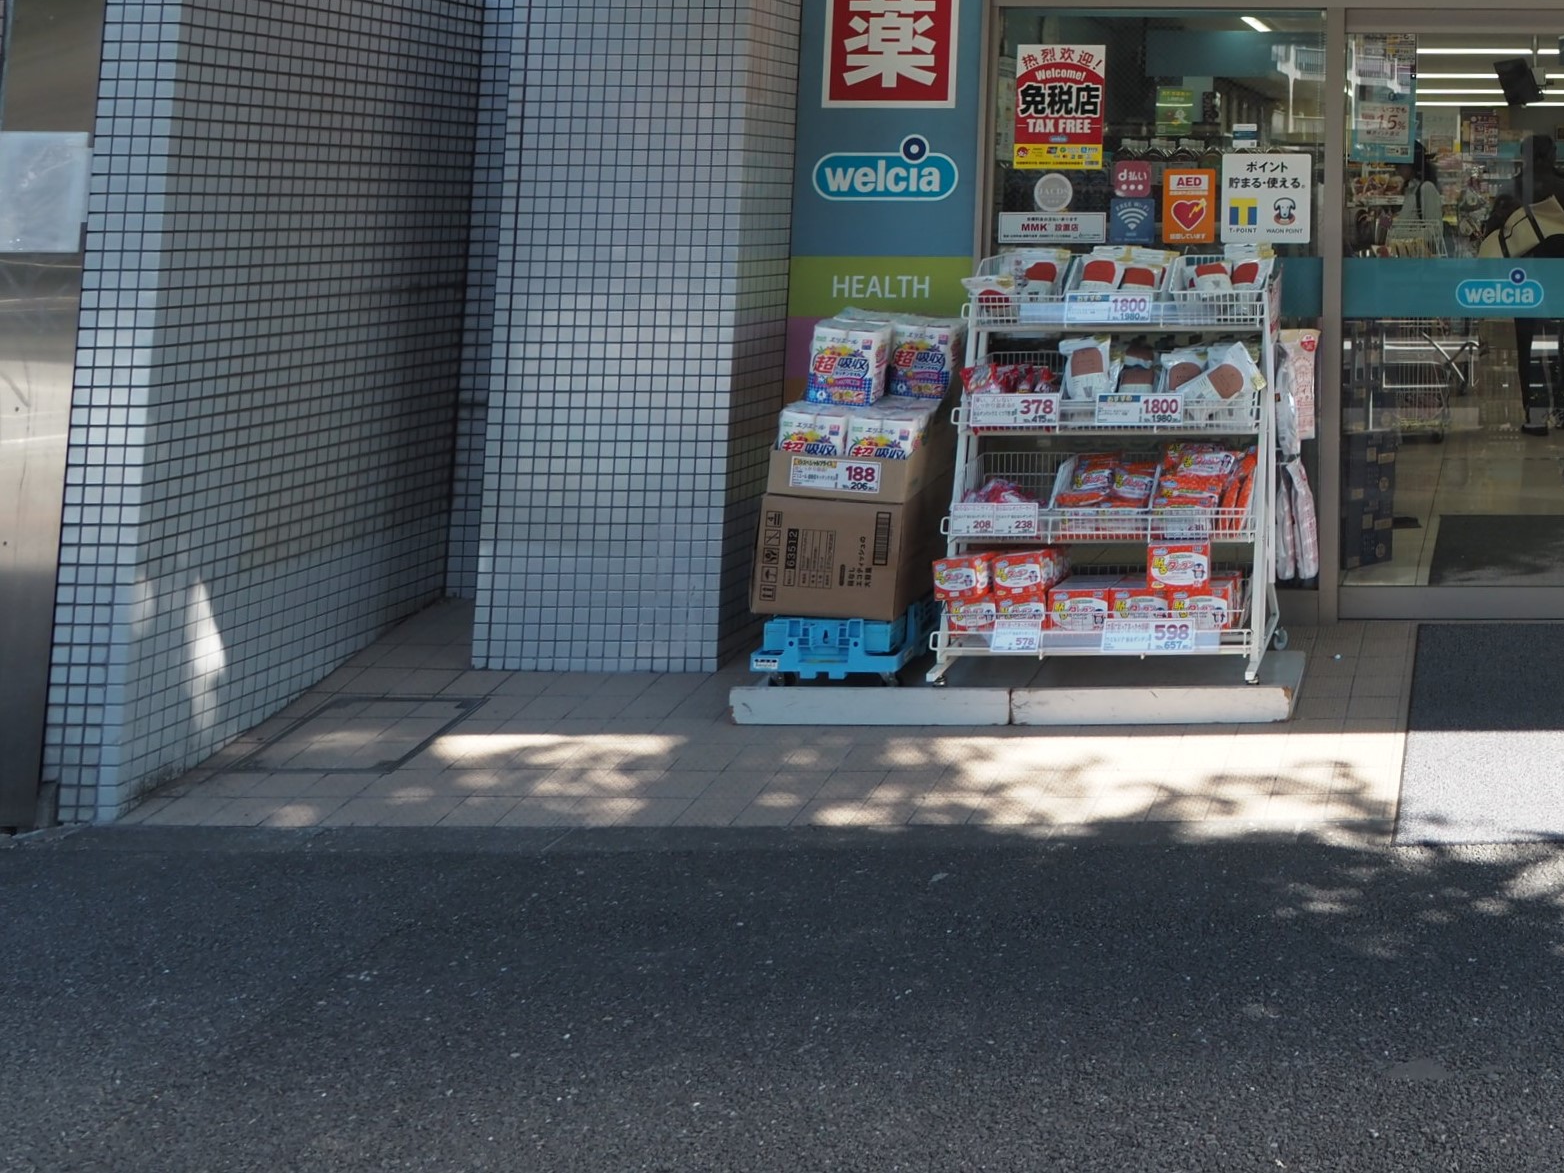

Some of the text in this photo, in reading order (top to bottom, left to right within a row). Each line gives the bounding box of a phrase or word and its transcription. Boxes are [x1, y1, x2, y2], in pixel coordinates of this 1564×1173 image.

[1035, 68, 1087, 82] Welcome!
[1019, 83, 1101, 117] 免税店
[1027, 119, 1092, 134] TAX FREE
[823, 150, 941, 194] welcia
[1246, 161, 1288, 173] ポイント
[1118, 169, 1148, 181] d払い
[1176, 176, 1202, 187] AED
[1021, 223, 1048, 232] MMK
[831, 275, 931, 300] HEALTH
[1463, 276, 1535, 305] welcia
[814, 354, 868, 374] 超吸収
[894, 349, 945, 368] 超吸収
[1020, 399, 1053, 415] 378
[1031, 415, 1046, 423] 415
[846, 466, 876, 483] 188
[850, 481, 868, 490] 206
[973, 520, 991, 529] 208
[1015, 520, 1033, 529] 238
[787, 530, 798, 567] 63512
[1154, 623, 1190, 641] 598
[1015, 637, 1035, 646] 578
[1164, 641, 1182, 650] 657
